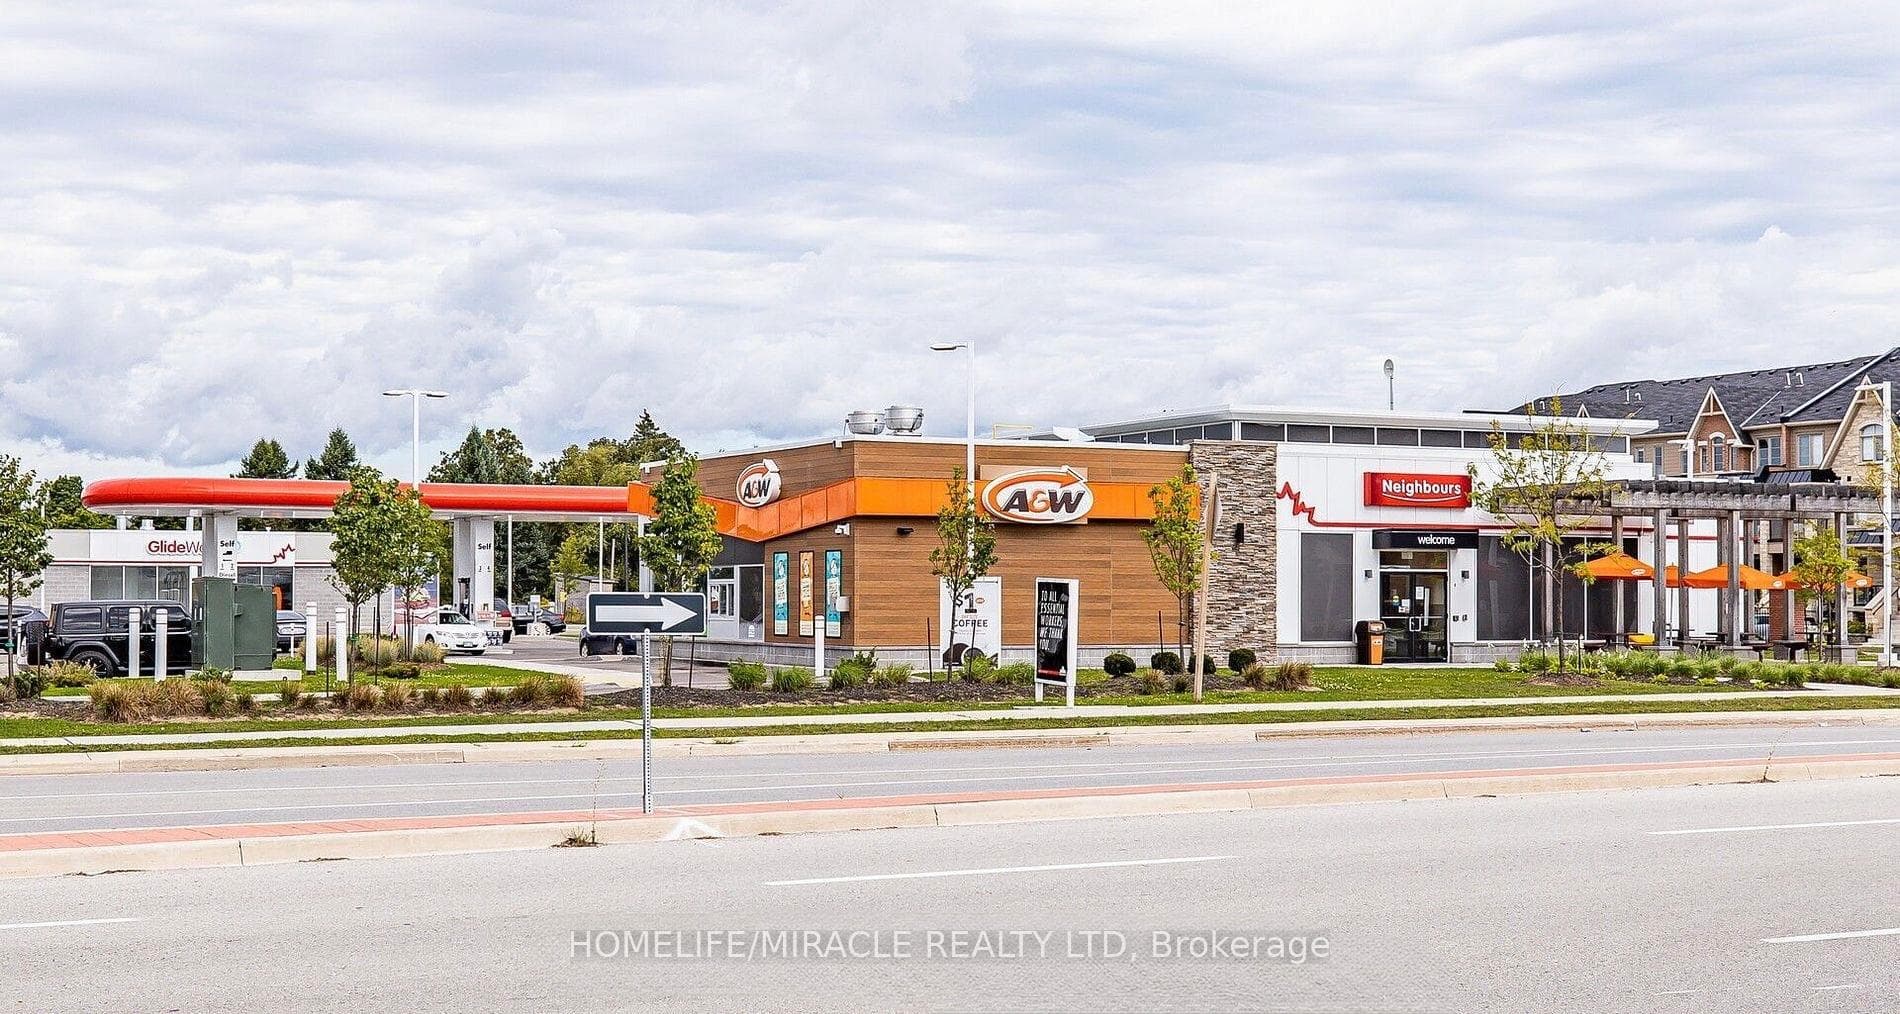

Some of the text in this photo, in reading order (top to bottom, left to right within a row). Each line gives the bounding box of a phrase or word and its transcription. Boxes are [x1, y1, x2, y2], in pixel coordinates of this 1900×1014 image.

[743, 478, 771, 500] A&W
[1382, 479, 1461, 496] Neighbours
[1001, 488, 1086, 513] A&W
[1417, 534, 1456, 545] welcome
[148, 540, 202, 553] GlideW
[1041, 590, 1057, 602] TO ALL
[1040, 602, 1065, 615] ESSENTIAL
[1039, 626, 1064, 639] WE THANK
